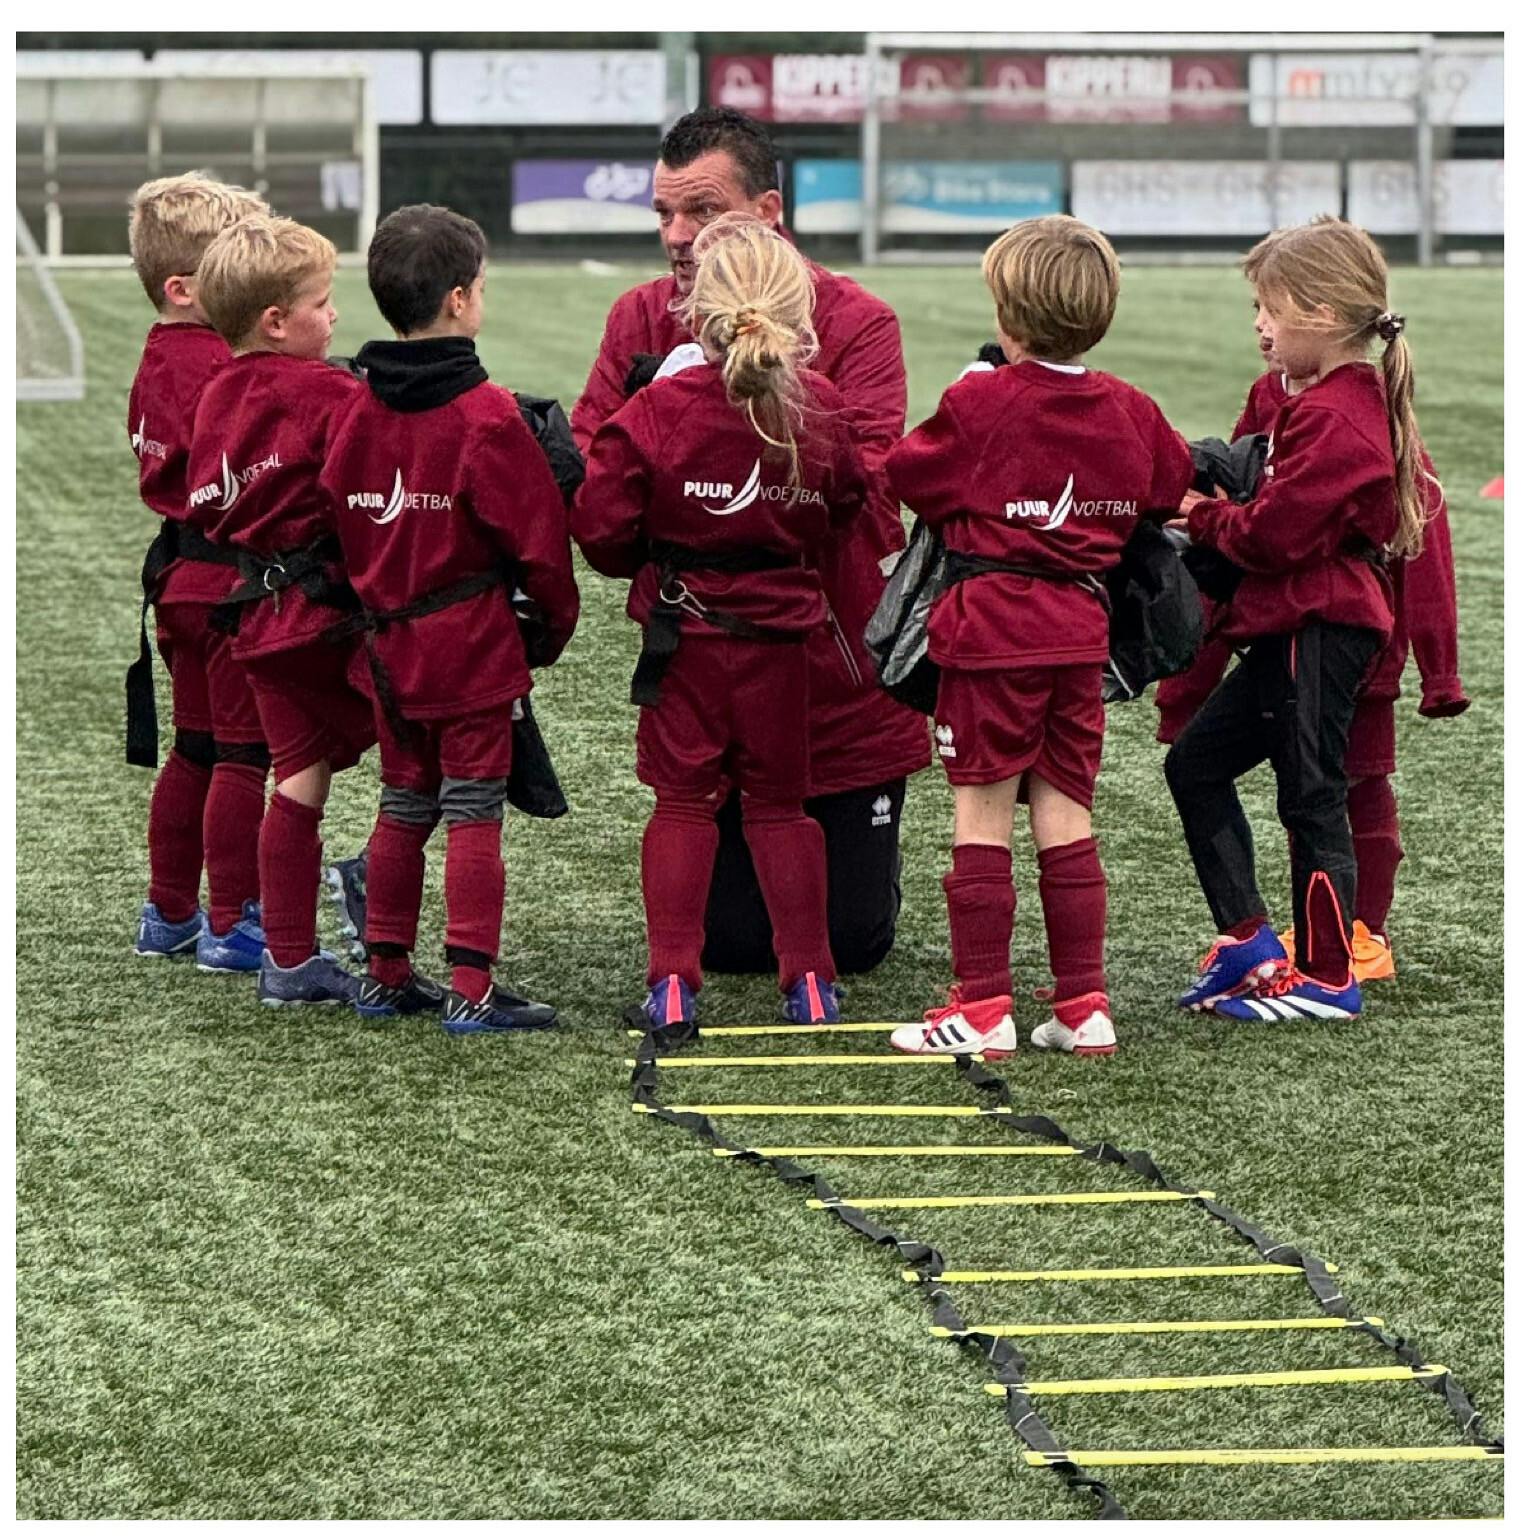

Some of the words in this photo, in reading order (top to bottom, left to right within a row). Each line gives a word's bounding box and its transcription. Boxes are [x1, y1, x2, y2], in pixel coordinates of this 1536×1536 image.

[189, 483, 222, 508] PUUR
[684, 482, 733, 498] PUUR
[347, 493, 385, 509] PUUR
[1006, 501, 1050, 519] PUUR
[1074, 501, 1138, 516] VOETBAL
